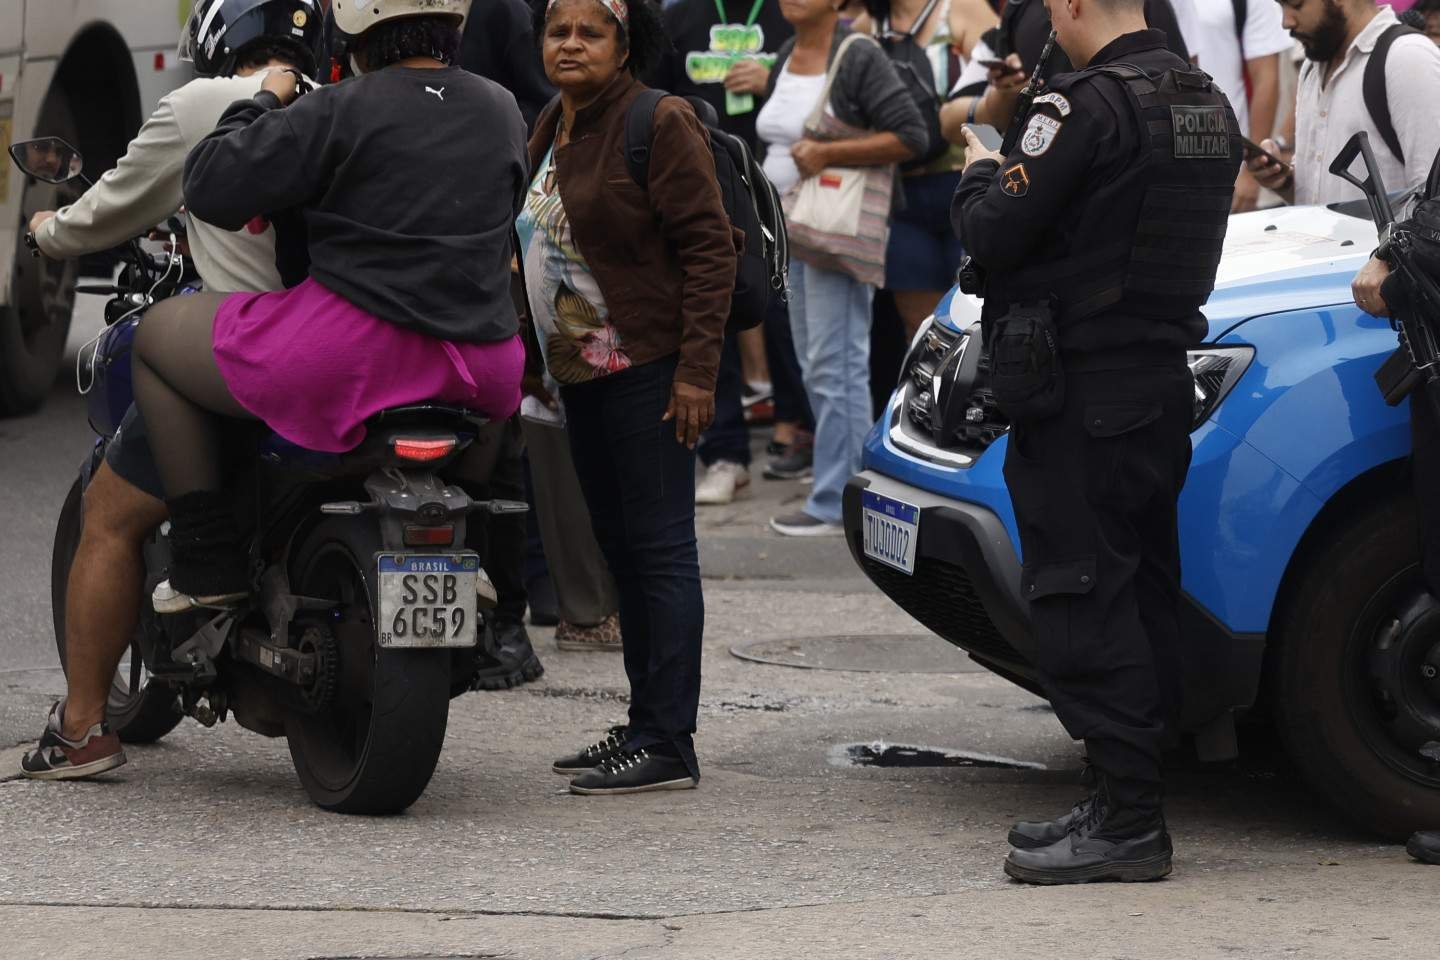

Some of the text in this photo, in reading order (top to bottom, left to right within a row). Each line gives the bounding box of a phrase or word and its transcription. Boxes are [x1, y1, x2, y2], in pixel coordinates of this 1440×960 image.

[1176, 135, 1228, 154] MILITAR
[411, 561, 449, 571] BRASIL
[402, 574, 457, 604] SSB
[392, 607, 465, 640] 6C59
[381, 631, 392, 644] BR
